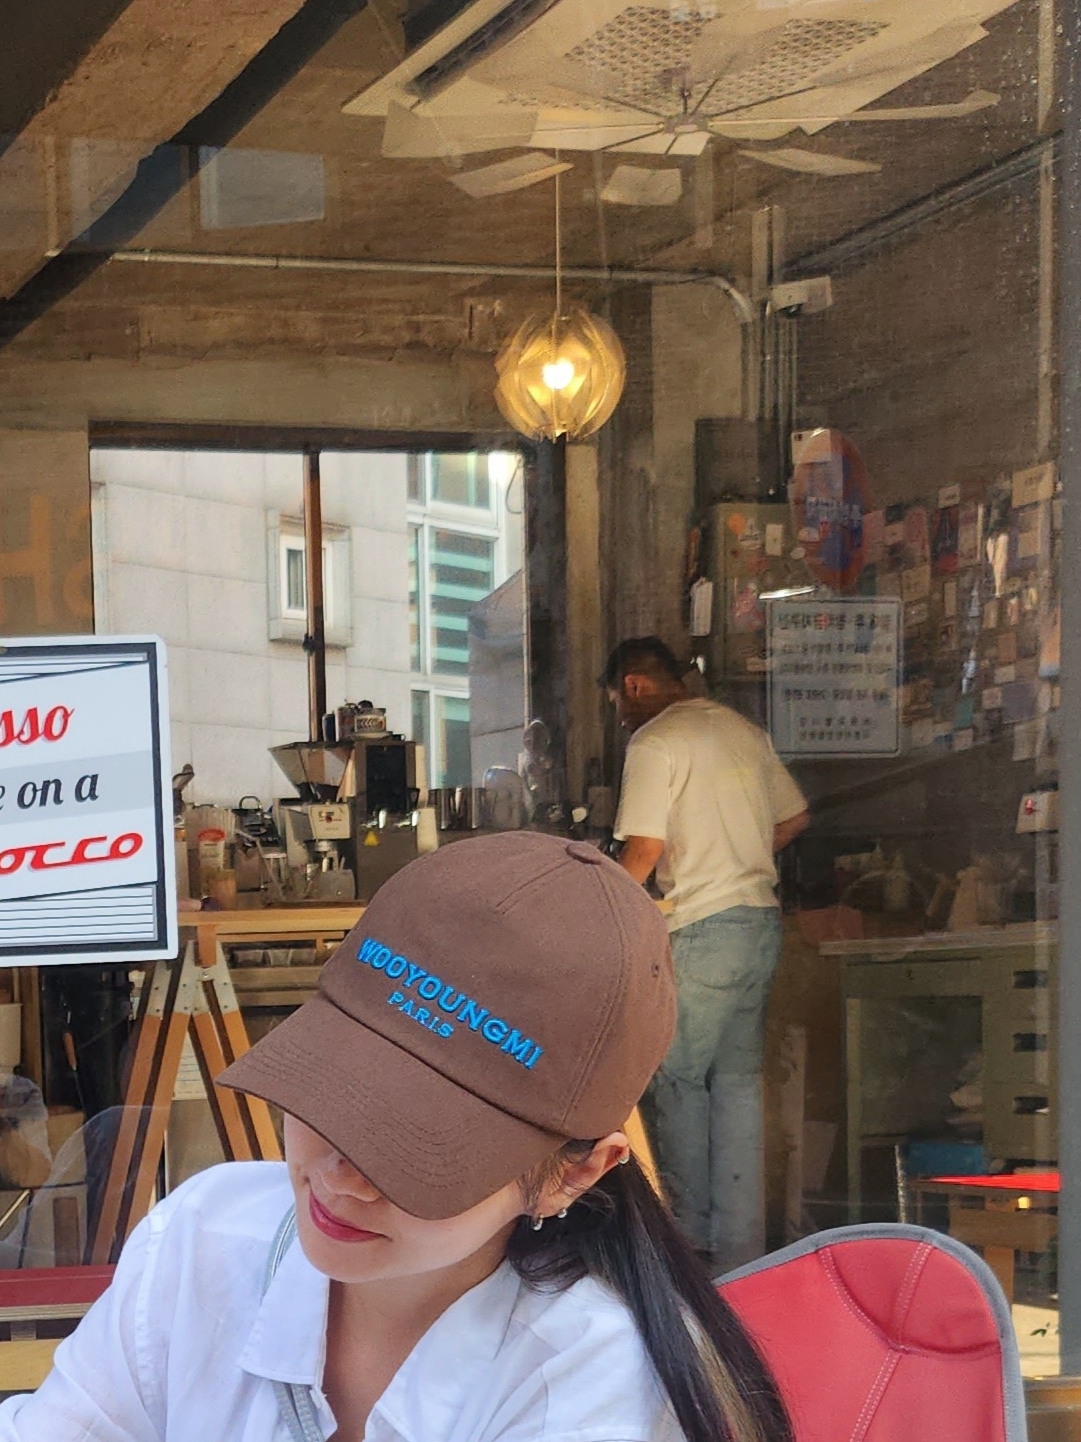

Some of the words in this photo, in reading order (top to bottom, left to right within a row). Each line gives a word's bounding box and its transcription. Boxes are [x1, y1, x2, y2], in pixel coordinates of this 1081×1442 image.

[16, 777, 62, 809] on
[74, 773, 100, 801] a
[356, 937, 545, 1071] WOOYOUNGMI
[386, 990, 455, 1039] PARIS
